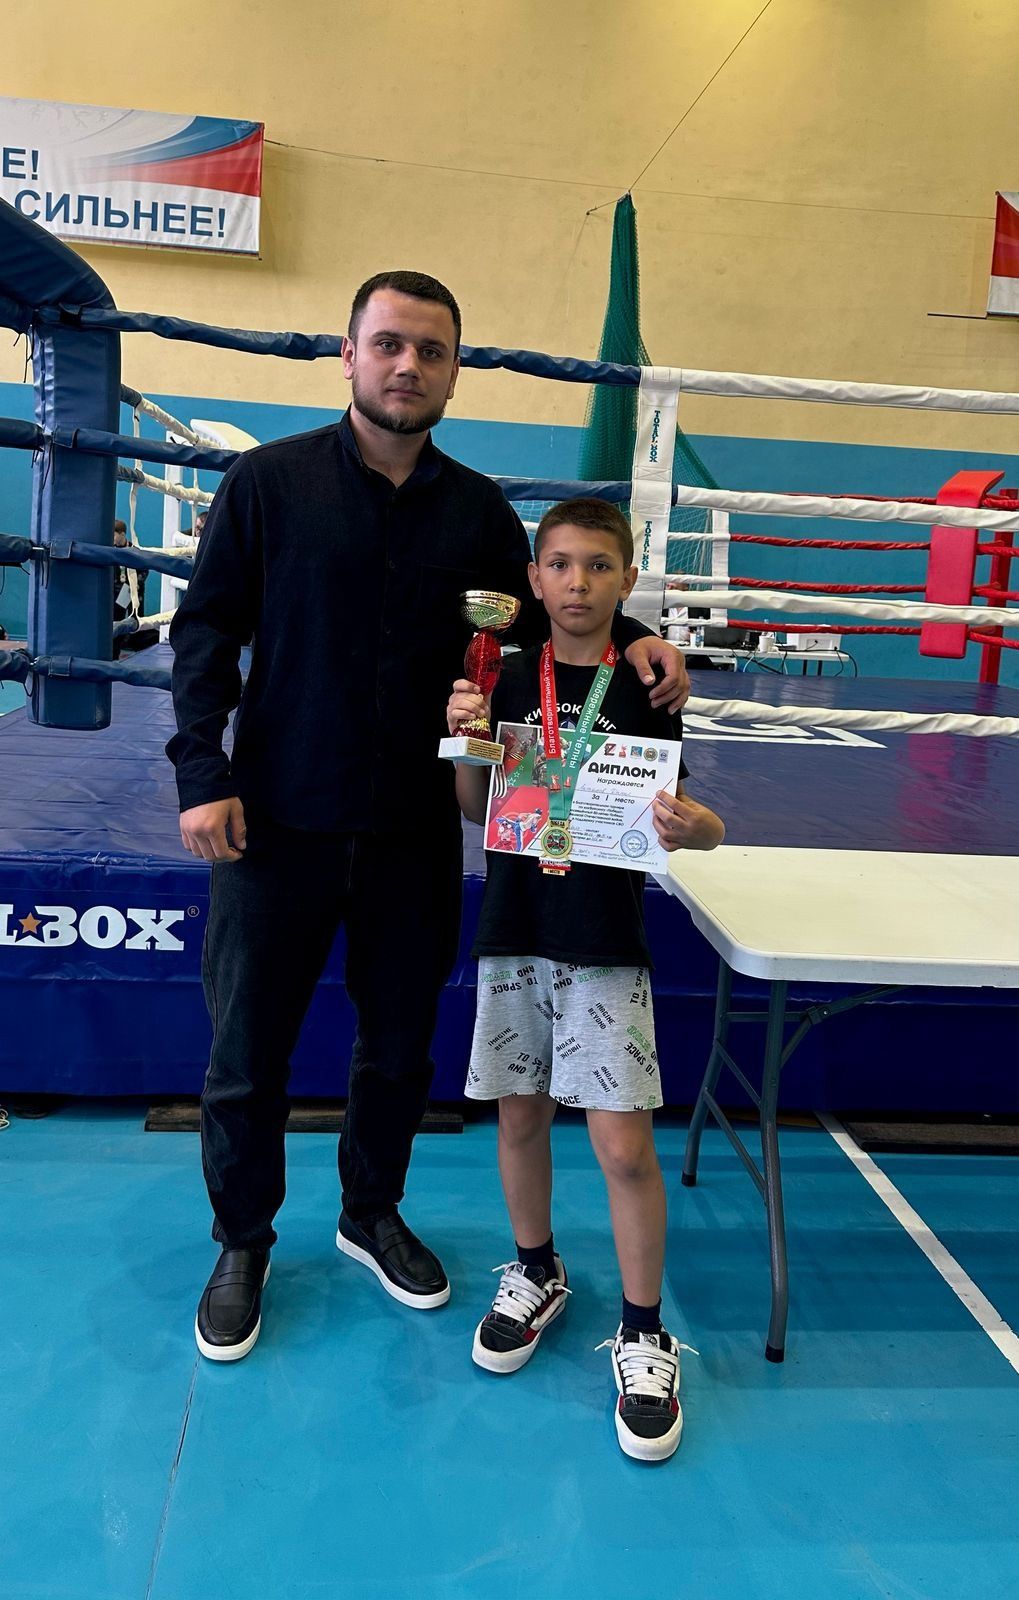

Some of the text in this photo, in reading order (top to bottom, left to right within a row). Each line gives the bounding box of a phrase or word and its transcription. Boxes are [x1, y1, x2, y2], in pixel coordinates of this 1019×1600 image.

[14, 189, 226, 238] СИЛЬНЕЕ!
[580, 676, 608, 734] Набережные
[524, 703, 617, 732] КИБОКИНГ
[569, 736, 587, 769] Челны
[588, 761, 657, 780] ДИПЛОМ
[597, 777, 645, 788] Награждается
[591, 793, 600, 801] За
[615, 797, 636, 805] место
[490, 976, 539, 995] TO SPACE
[553, 977, 573, 990] AND
[587, 1007, 606, 1030] BEYOND
[595, 1002, 616, 1026] IMAGINE
[487, 1026, 513, 1047] IMAGINE
[494, 1032, 519, 1052] BEYOND
[555, 1036, 576, 1053] BEYOND
[517, 1052, 530, 1063] TO
[560, 1043, 582, 1060] IMAGINE
[623, 1042, 647, 1066] SPACE
[508, 1063, 527, 1074] AND
[601, 1065, 619, 1089] BEYOND
[593, 1069, 611, 1093] IMAGINE
